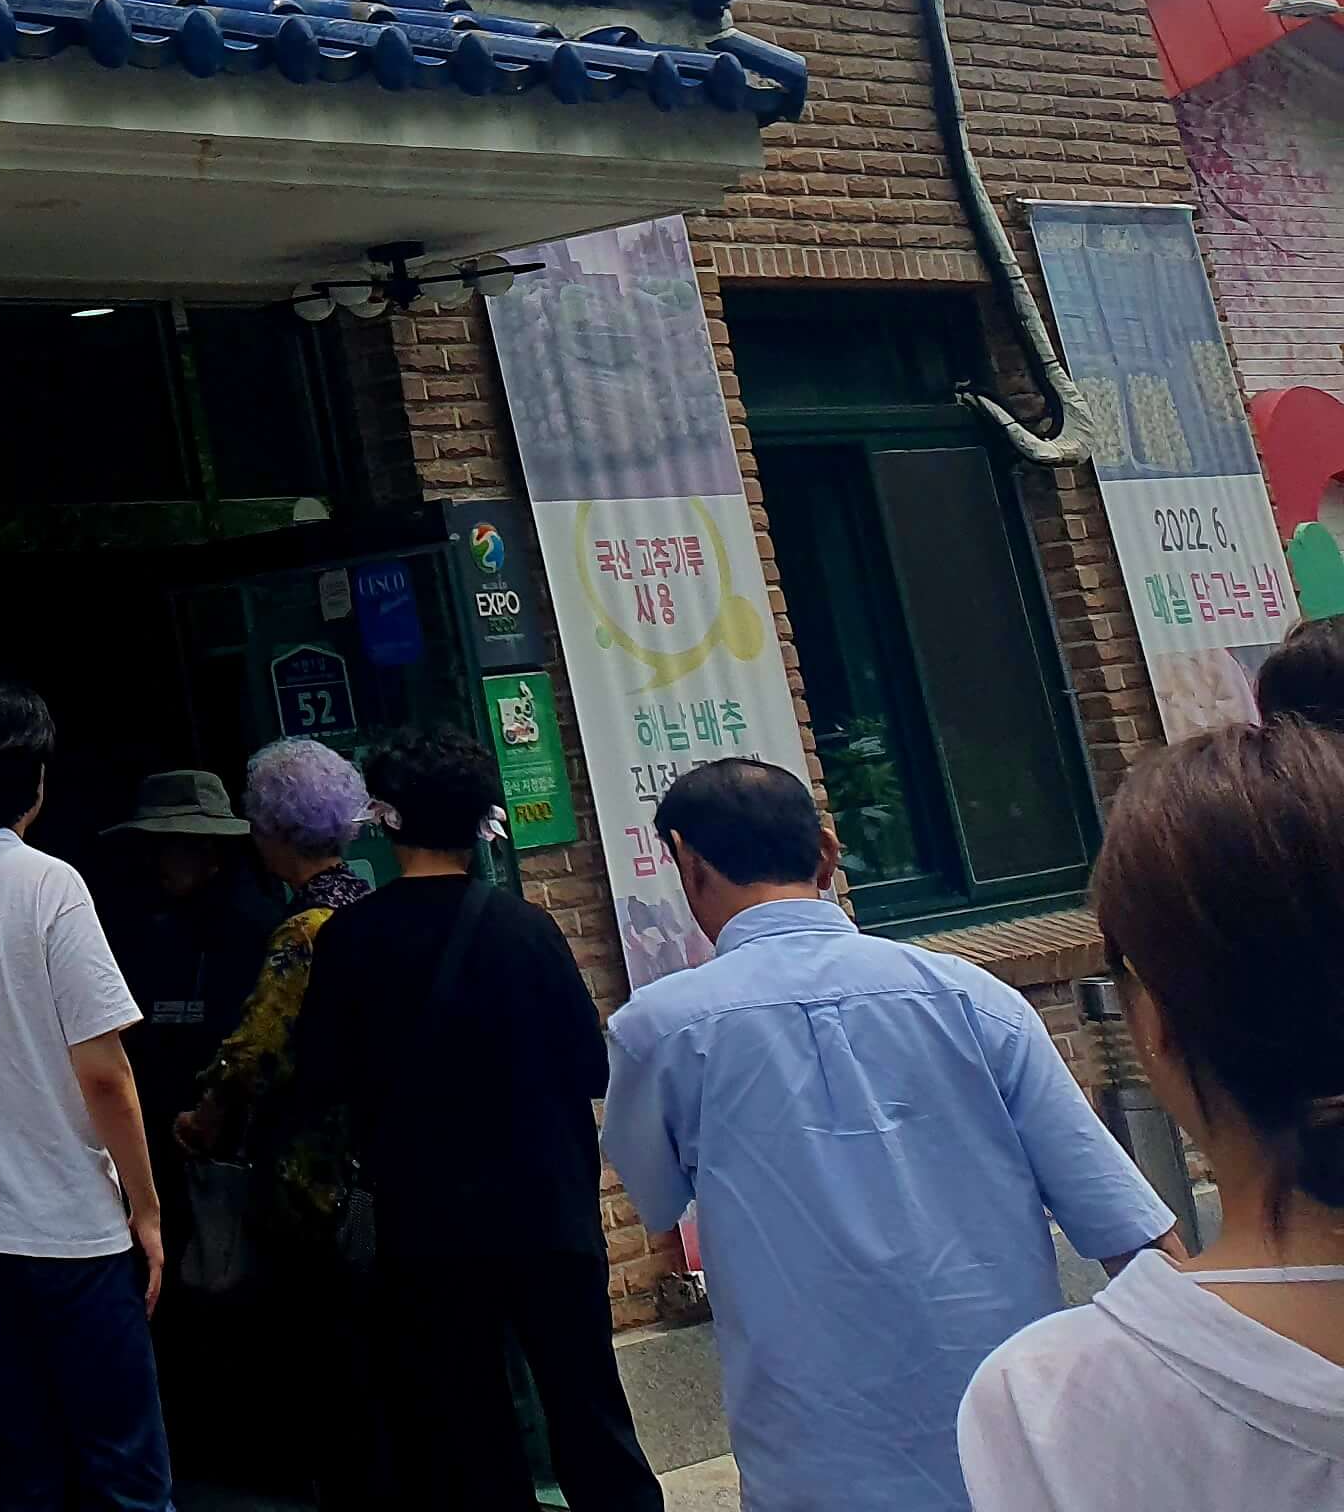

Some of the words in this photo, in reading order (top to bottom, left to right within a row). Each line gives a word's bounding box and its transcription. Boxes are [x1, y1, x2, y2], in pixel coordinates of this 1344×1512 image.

[595, 539, 633, 580] 국산
[636, 536, 705, 578] 고추가루
[475, 590, 520, 616] EXPO
[634, 583, 675, 625] 사용
[1144, 573, 1193, 625] 매실
[297, 690, 337, 727] 52
